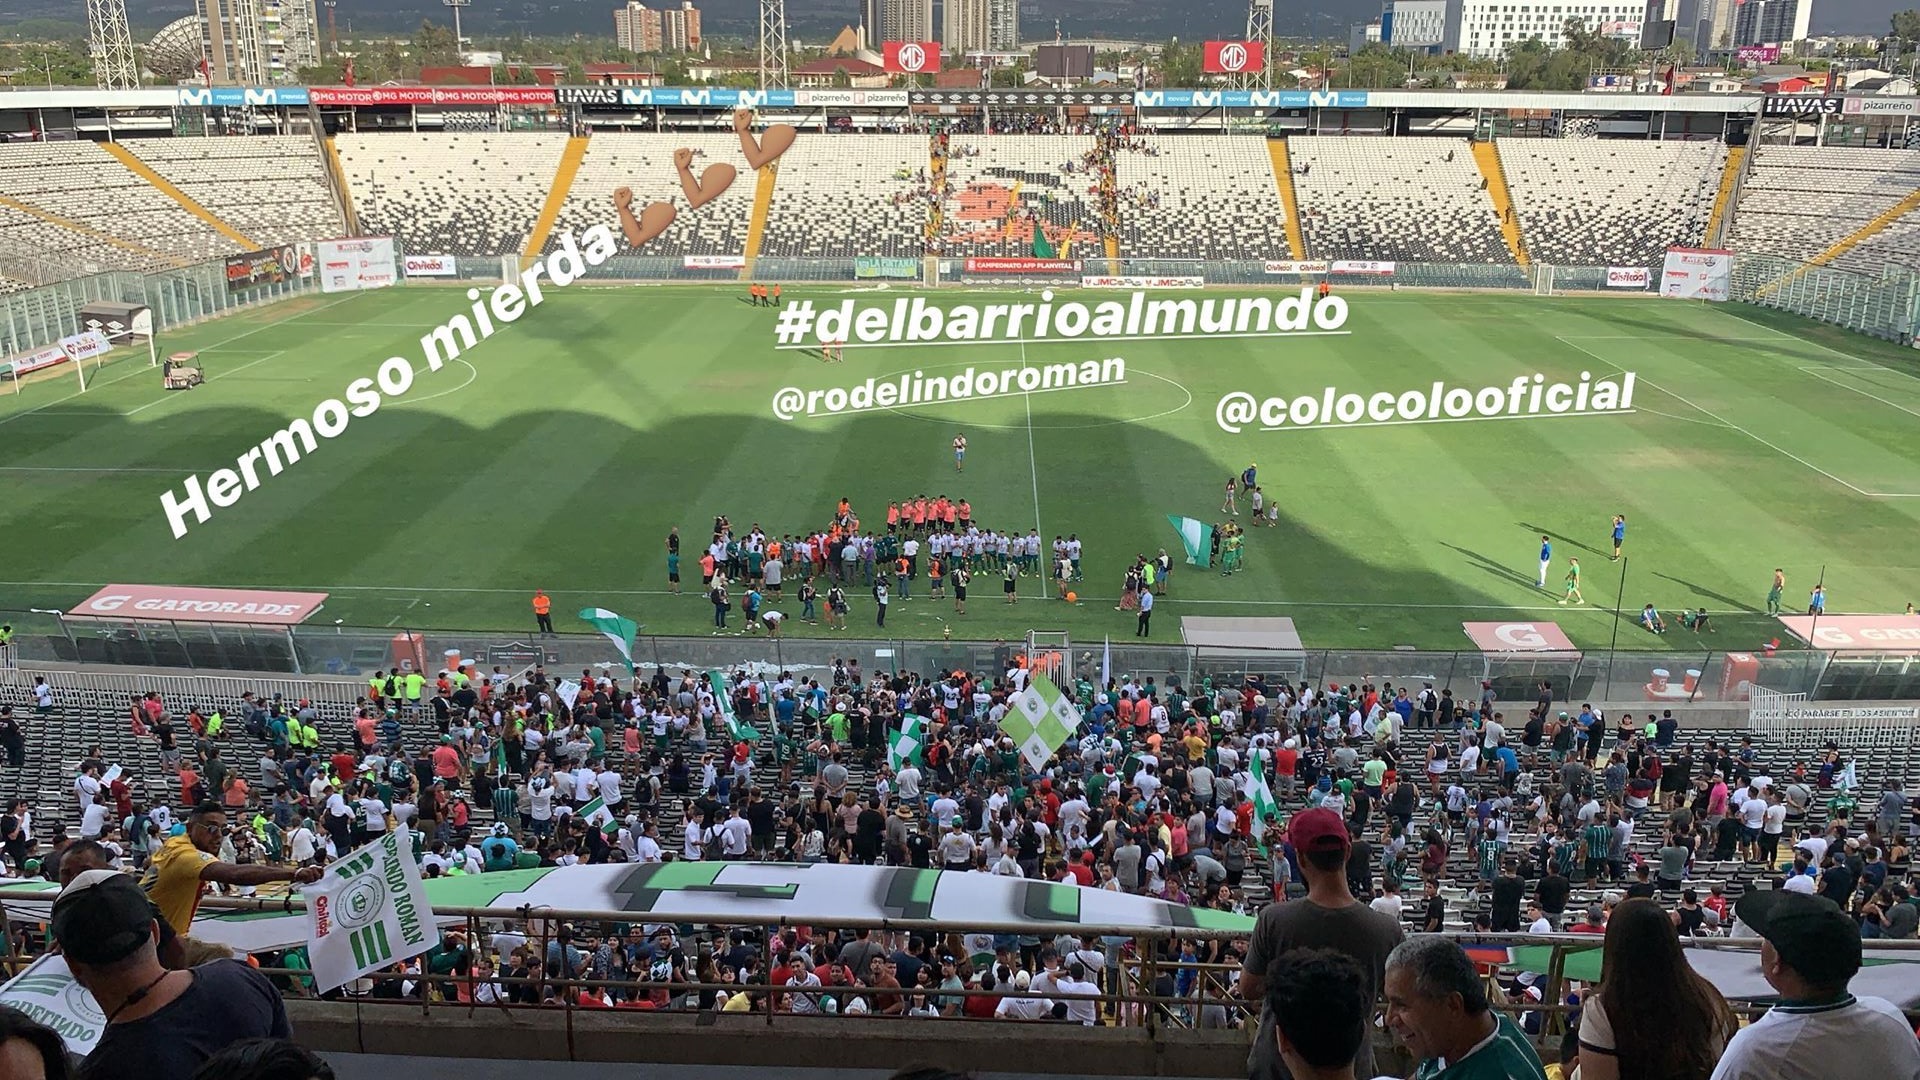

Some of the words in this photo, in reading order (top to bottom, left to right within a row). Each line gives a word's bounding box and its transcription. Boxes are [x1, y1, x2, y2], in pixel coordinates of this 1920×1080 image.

[338, 92, 372, 101] MOTOR
[400, 92, 432, 100] MOTOR
[462, 92, 495, 100] MOTOR
[522, 92, 554, 100] MOTOR
[558, 89, 617, 103] HAVAS
[812, 93, 850, 102] pizarreño
[867, 93, 906, 102] pizarreño
[1766, 98, 1837, 113] HAVAS
[1863, 101, 1912, 111] pizarreño
[134, 598, 302, 616] GATORADE
[1311, 756, 1323, 768] 23
[394, 893, 424, 946] ROMAN
